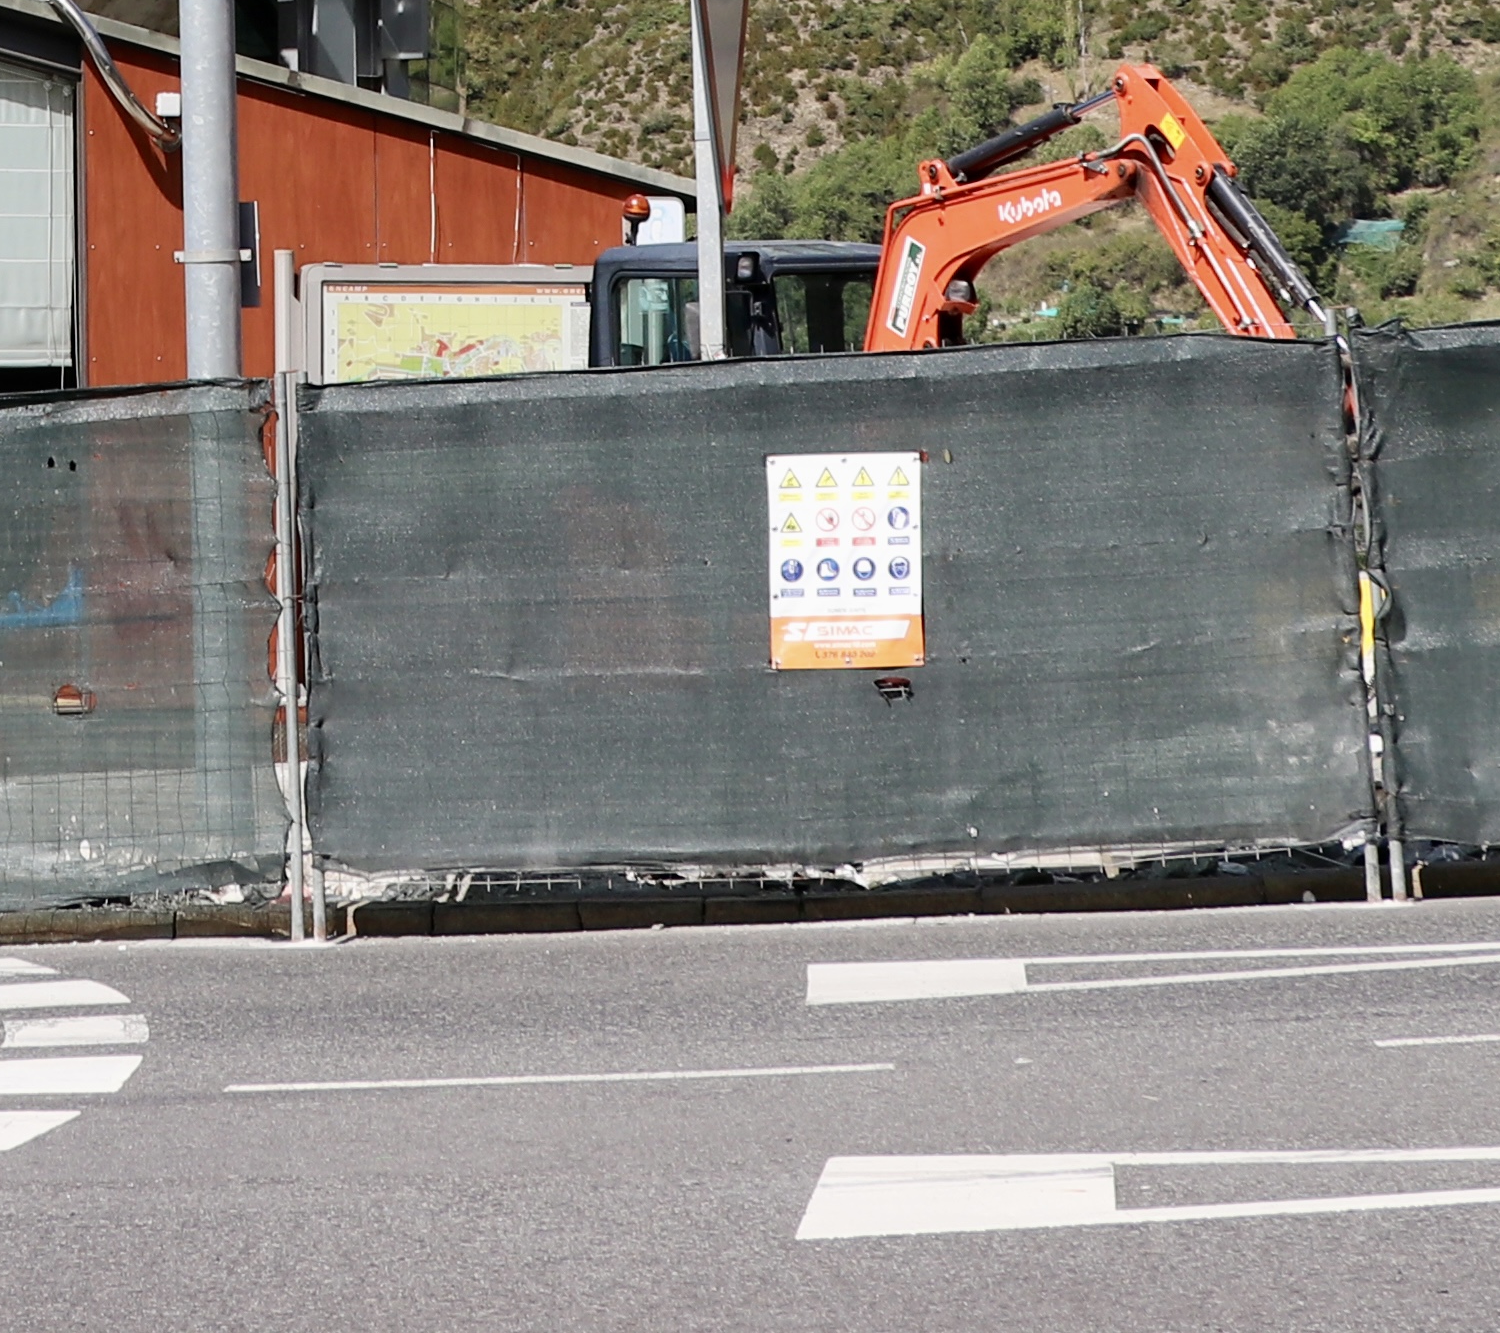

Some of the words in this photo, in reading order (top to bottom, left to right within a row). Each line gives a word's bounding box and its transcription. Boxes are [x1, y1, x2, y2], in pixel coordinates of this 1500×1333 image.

[997, 188, 1062, 224] Kubota
[895, 261, 920, 331] PURROY
[817, 625, 873, 637] SIMAC
